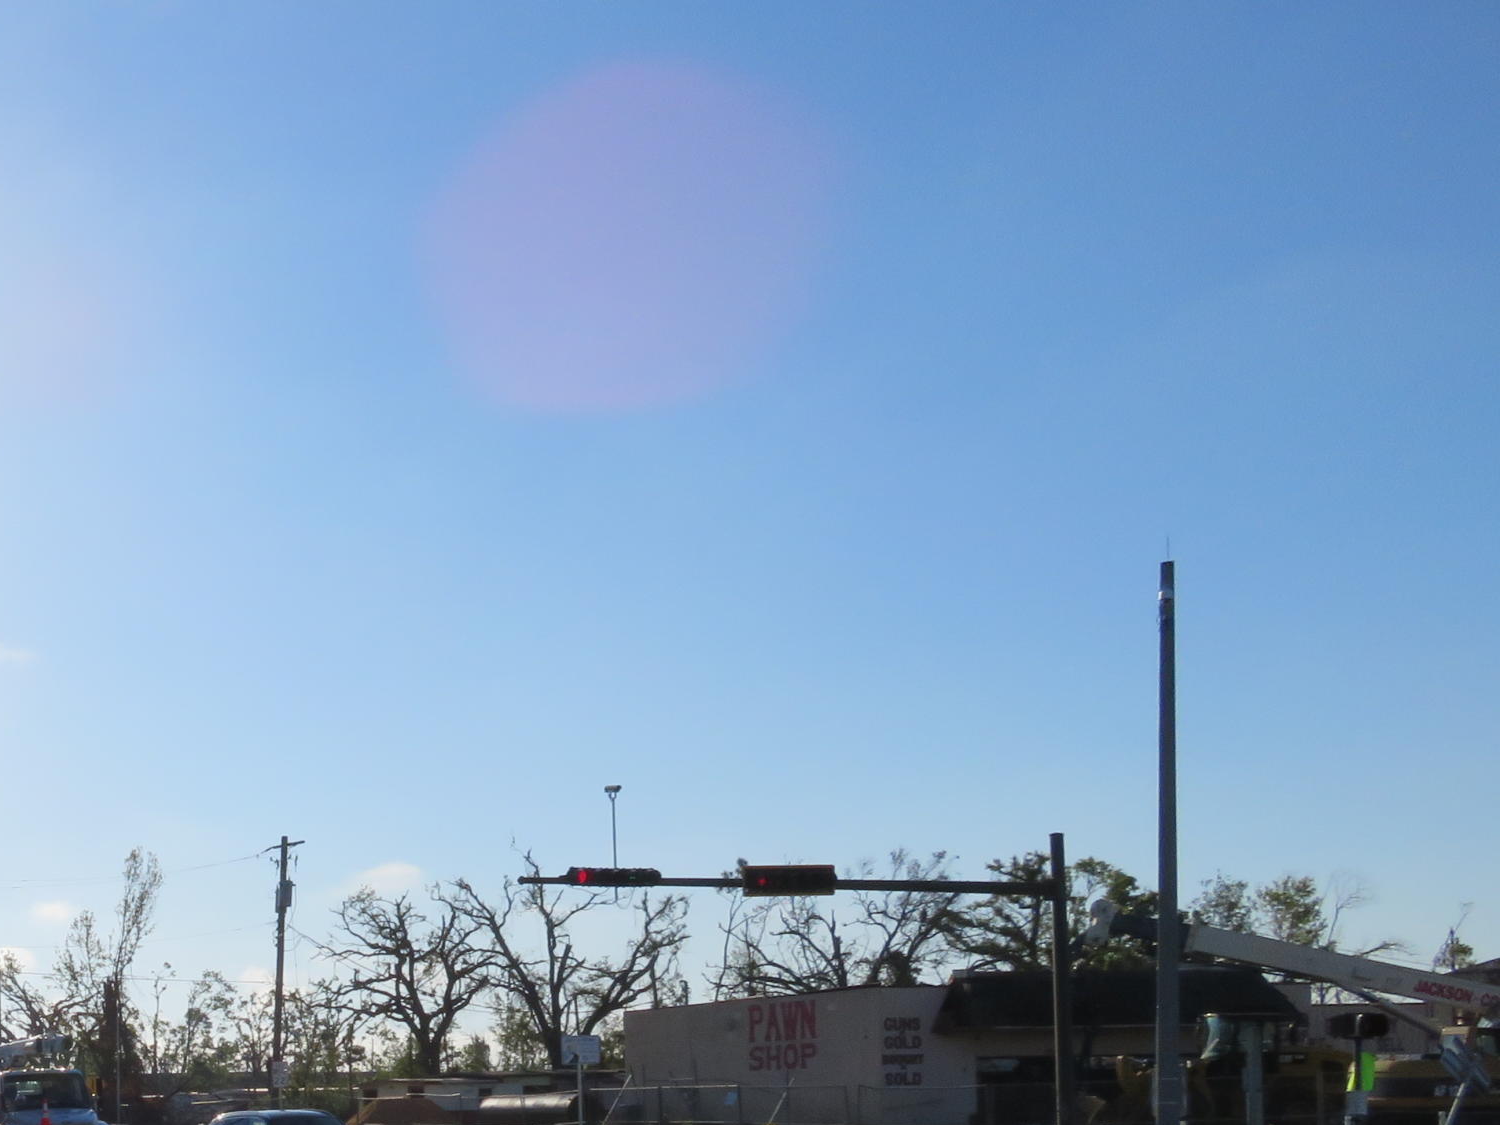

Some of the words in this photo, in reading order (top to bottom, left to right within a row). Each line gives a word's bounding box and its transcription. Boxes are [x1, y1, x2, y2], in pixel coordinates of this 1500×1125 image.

[1413, 981, 1473, 1003] JACKSON
[747, 999, 818, 1043] PAWN
[883, 1016, 921, 1032] GUNS
[883, 1035, 922, 1050] GOLD
[748, 1043, 817, 1072] SHOP
[885, 1071, 922, 1086] SOLD
